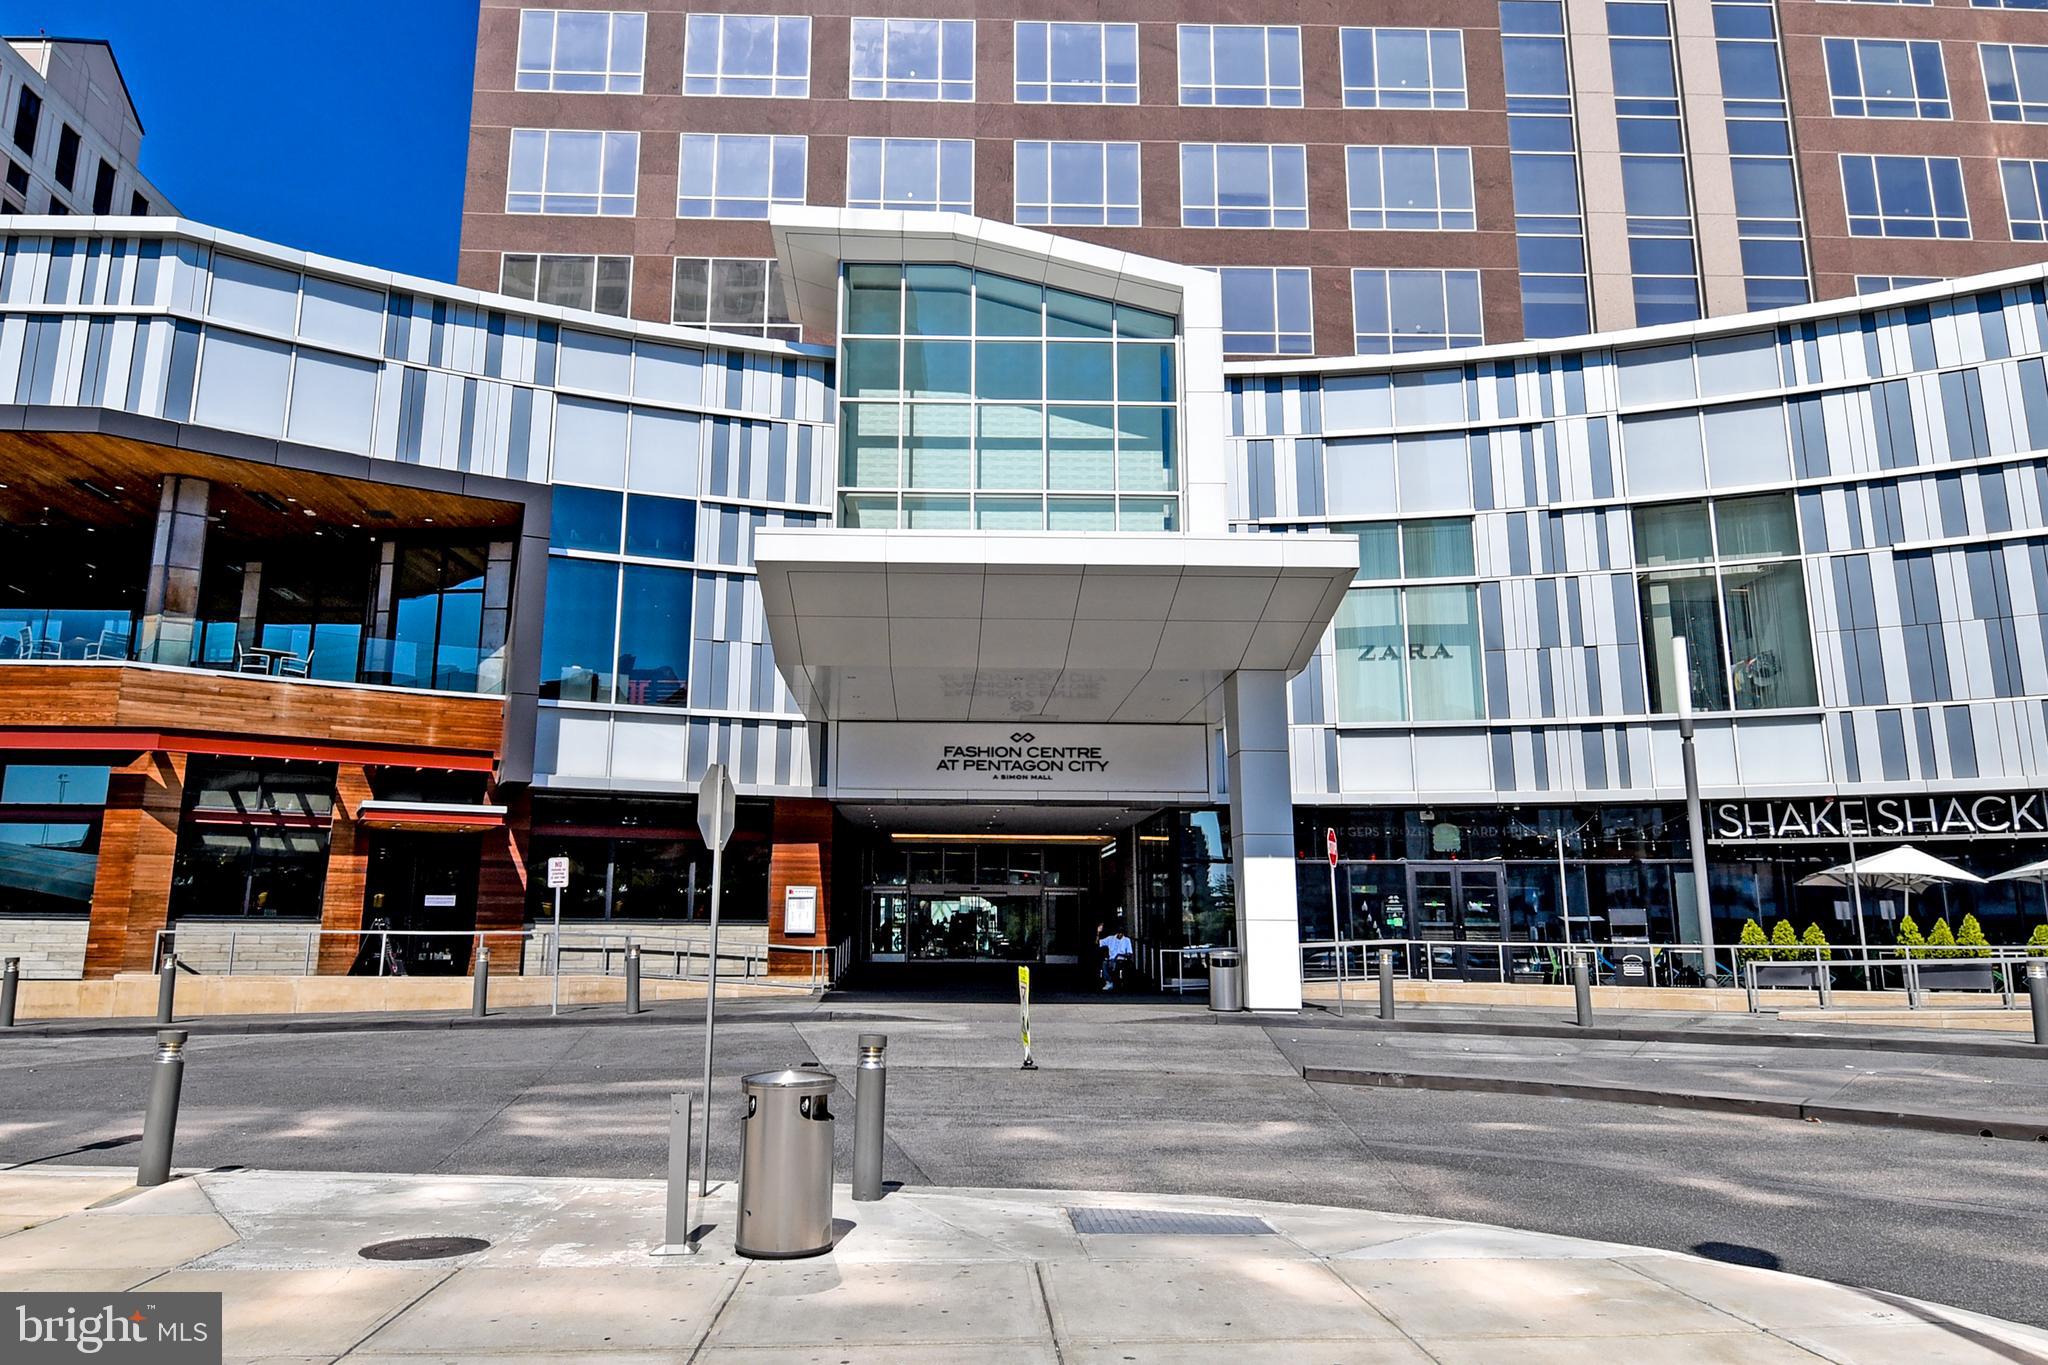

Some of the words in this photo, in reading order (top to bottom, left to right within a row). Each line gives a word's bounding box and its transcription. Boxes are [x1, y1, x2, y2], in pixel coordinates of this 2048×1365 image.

[1358, 643, 1453, 661] ZARA
[943, 746, 1022, 758] FASHION
[1027, 747, 1102, 759] CENTRE
[936, 759, 959, 771] AT
[963, 759, 1063, 771] PENTAGON
[1068, 760, 1109, 772] CITY
[1718, 800, 1868, 838] SHAKE
[1877, 794, 2045, 834] SHACK
